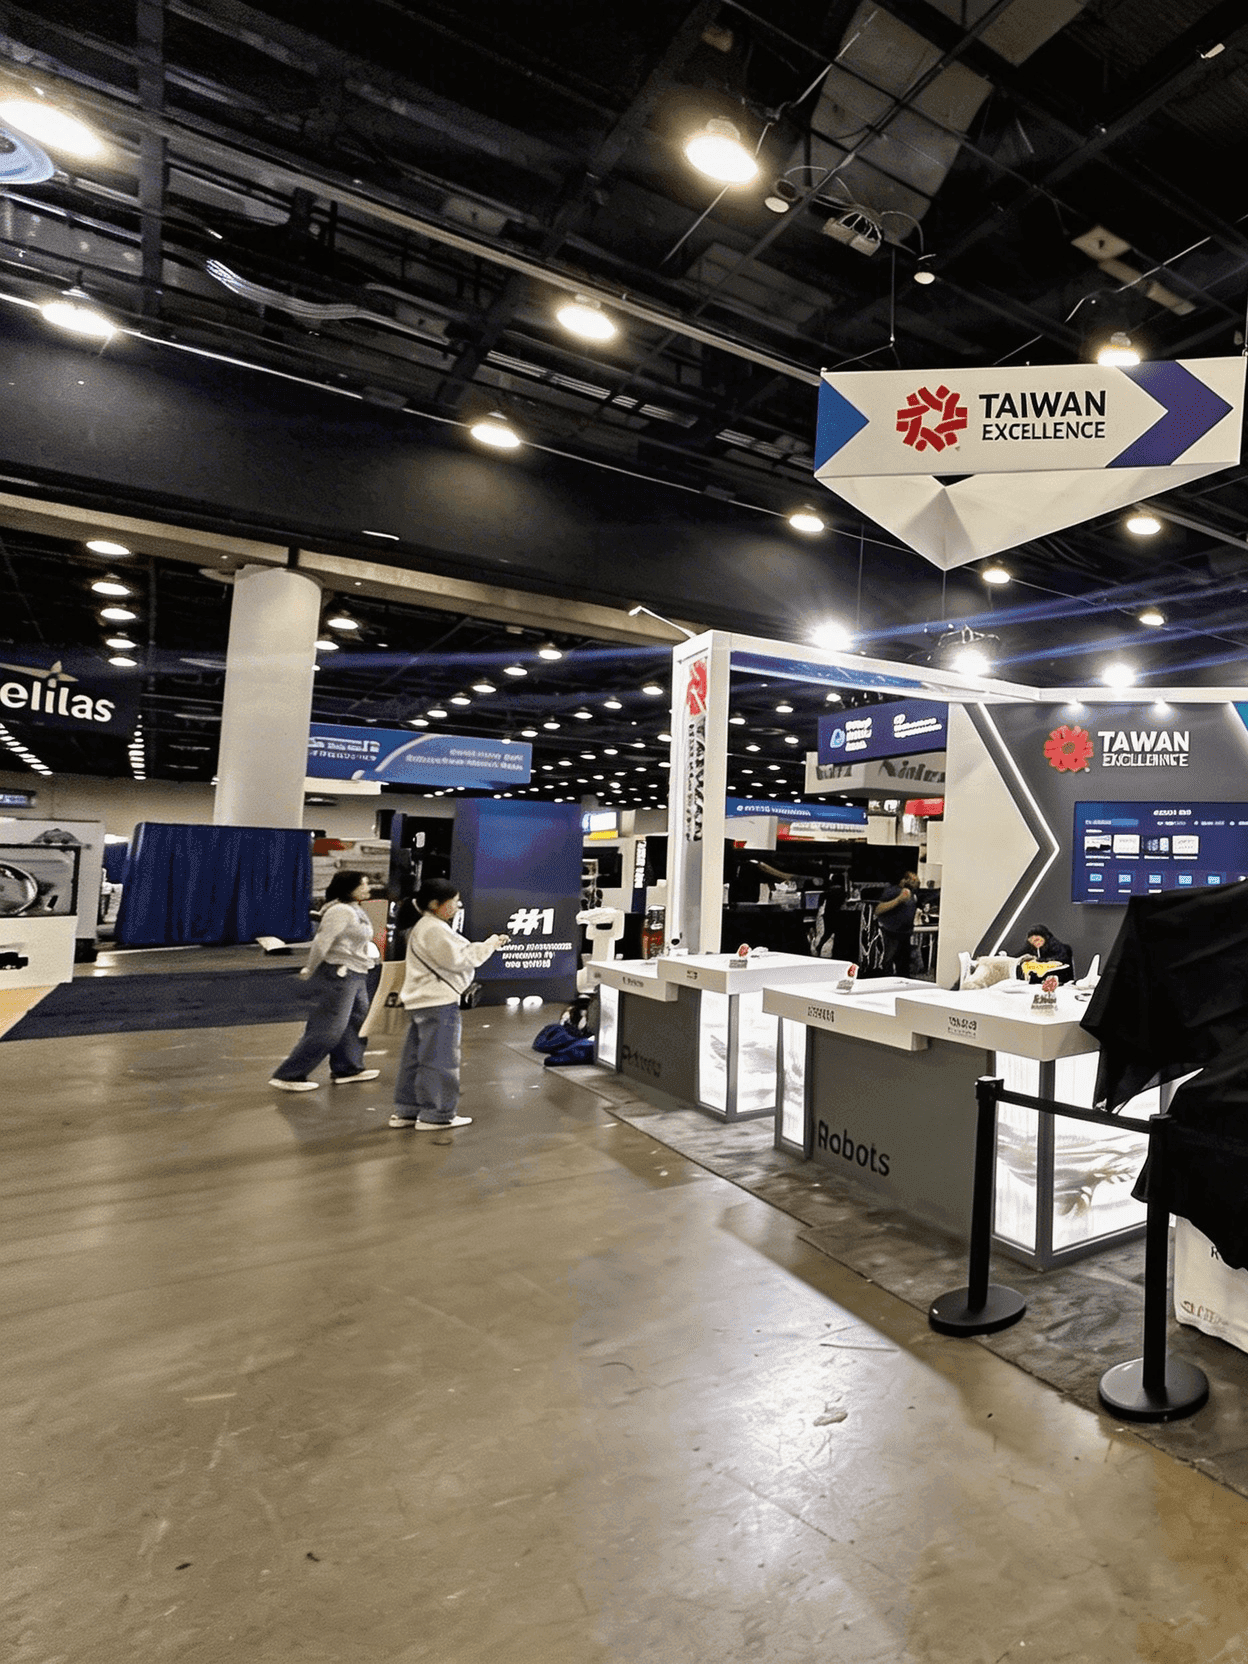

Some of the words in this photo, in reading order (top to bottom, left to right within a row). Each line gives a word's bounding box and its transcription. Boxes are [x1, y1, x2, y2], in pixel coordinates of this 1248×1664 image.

[978, 390, 1107, 419] TAIWAN
[981, 421, 1106, 441] EXCELLENCE
[506, 907, 555, 936] #1
[817, 1119, 891, 1178] Robots
